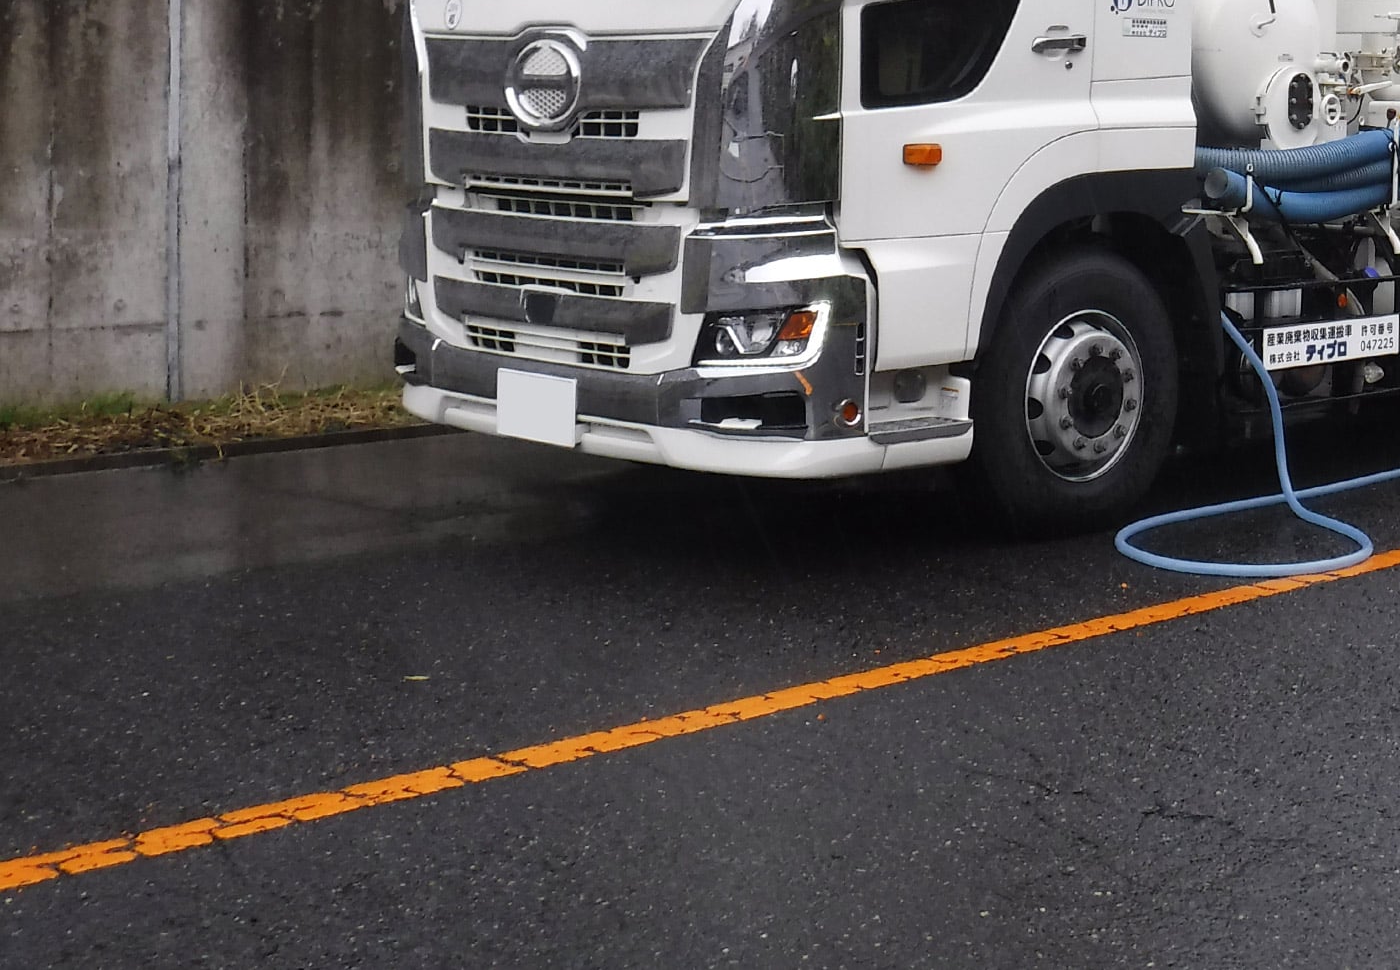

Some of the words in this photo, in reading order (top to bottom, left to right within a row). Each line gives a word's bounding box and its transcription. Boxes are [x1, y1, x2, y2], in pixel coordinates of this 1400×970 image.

[1266, 324, 1353, 347] 産業廃棄物収集運搬車
[1361, 322, 1394, 337] 許可番号
[1360, 337, 1394, 352] 047225
[1269, 350, 1300, 365] 株式会社
